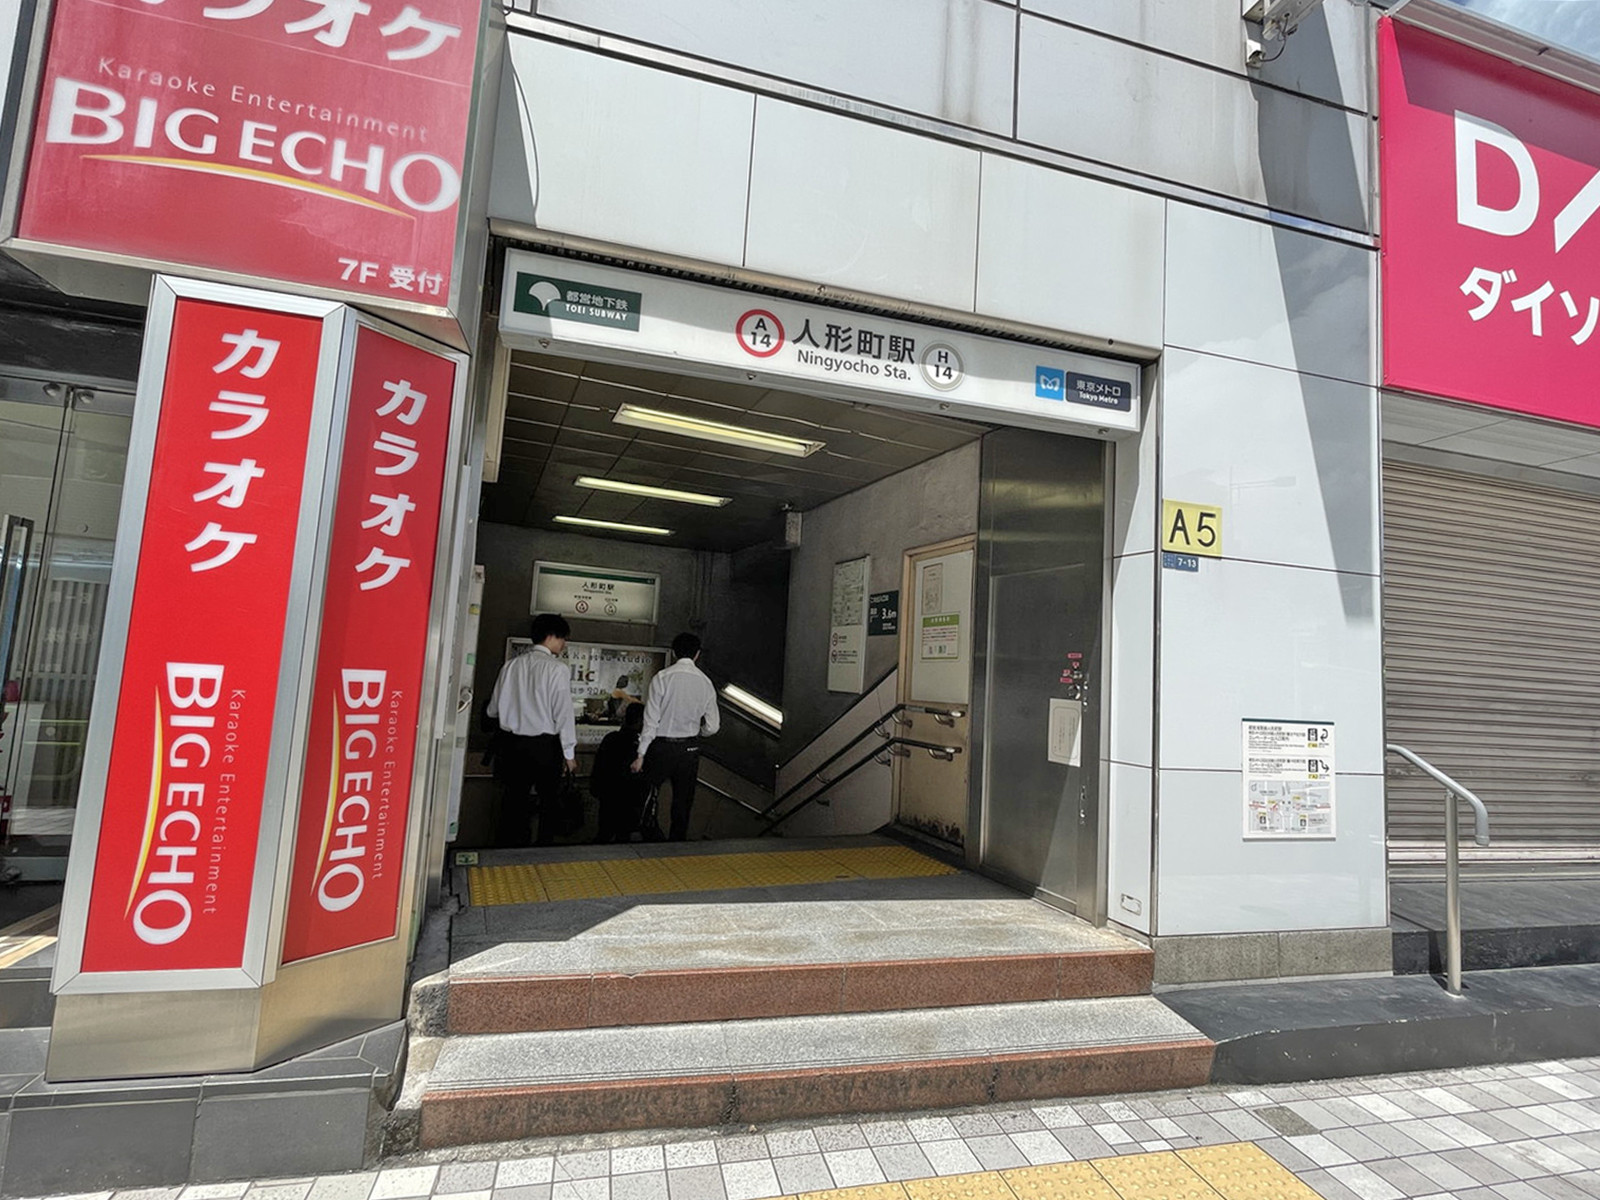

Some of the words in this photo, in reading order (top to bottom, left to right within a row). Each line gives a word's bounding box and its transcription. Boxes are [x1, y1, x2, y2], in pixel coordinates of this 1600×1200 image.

[98, 57, 216, 97] Karaoke
[231, 85, 427, 142] Entertainment
[46, 77, 219, 155] BIG
[238, 119, 460, 212] ECHO
[338, 257, 379, 284] 7F
[389, 267, 443, 295] 受付
[565, 303, 586, 314] TOEI
[589, 307, 627, 320] SUBWAY
[566, 290, 629, 310] 都営地下鉄
[750, 331, 772, 348] 14
[755, 318, 767, 331] A
[791, 319, 916, 365] 人形町駅
[797, 349, 880, 376] Ningyocho
[883, 363, 911, 381] Sta.
[934, 364, 953, 381] 14
[938, 351, 948, 363] H
[1076, 380, 1121, 396] 東京メトロ
[1079, 391, 1098, 402] Tokyo
[1099, 394, 1118, 404] Metro
[185, 329, 281, 573] カラオケ
[354, 379, 427, 591] カラオケ
[1169, 508, 1217, 547] A5
[1177, 557, 1197, 568] 7-13
[166, 662, 224, 768] BIG
[224, 688, 246, 764] Karaoke
[341, 668, 387, 760] BIG
[385, 689, 403, 754] Karaoke
[202, 773, 235, 915] Entertainment
[317, 771, 372, 912] ECHO
[372, 761, 396, 881] Entertainment
[132, 783, 205, 945] ECHO
